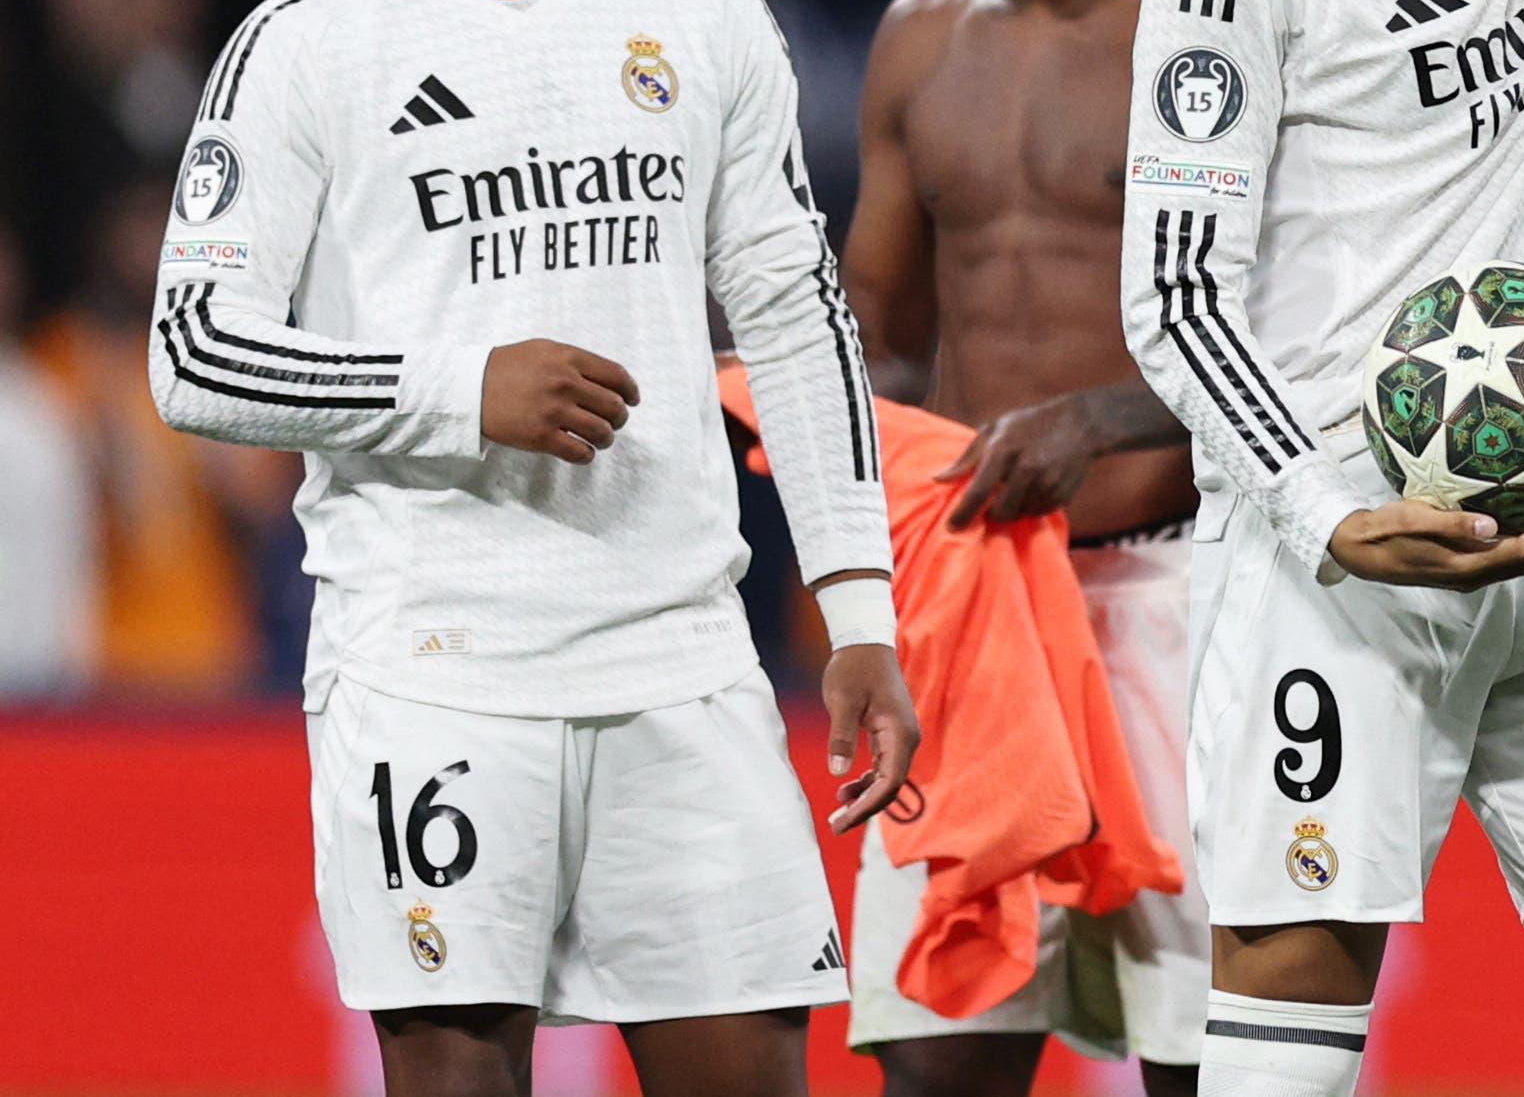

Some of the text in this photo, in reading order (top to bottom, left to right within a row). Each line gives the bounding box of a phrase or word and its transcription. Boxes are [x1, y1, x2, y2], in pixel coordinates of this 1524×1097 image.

[1186, 91, 1213, 113] 15
[191, 178, 213, 198] 15
[410, 145, 686, 232] Emirates
[470, 215, 661, 285] FLY BETTER
[1273, 668, 1343, 803] 9
[369, 759, 478, 890] 16
